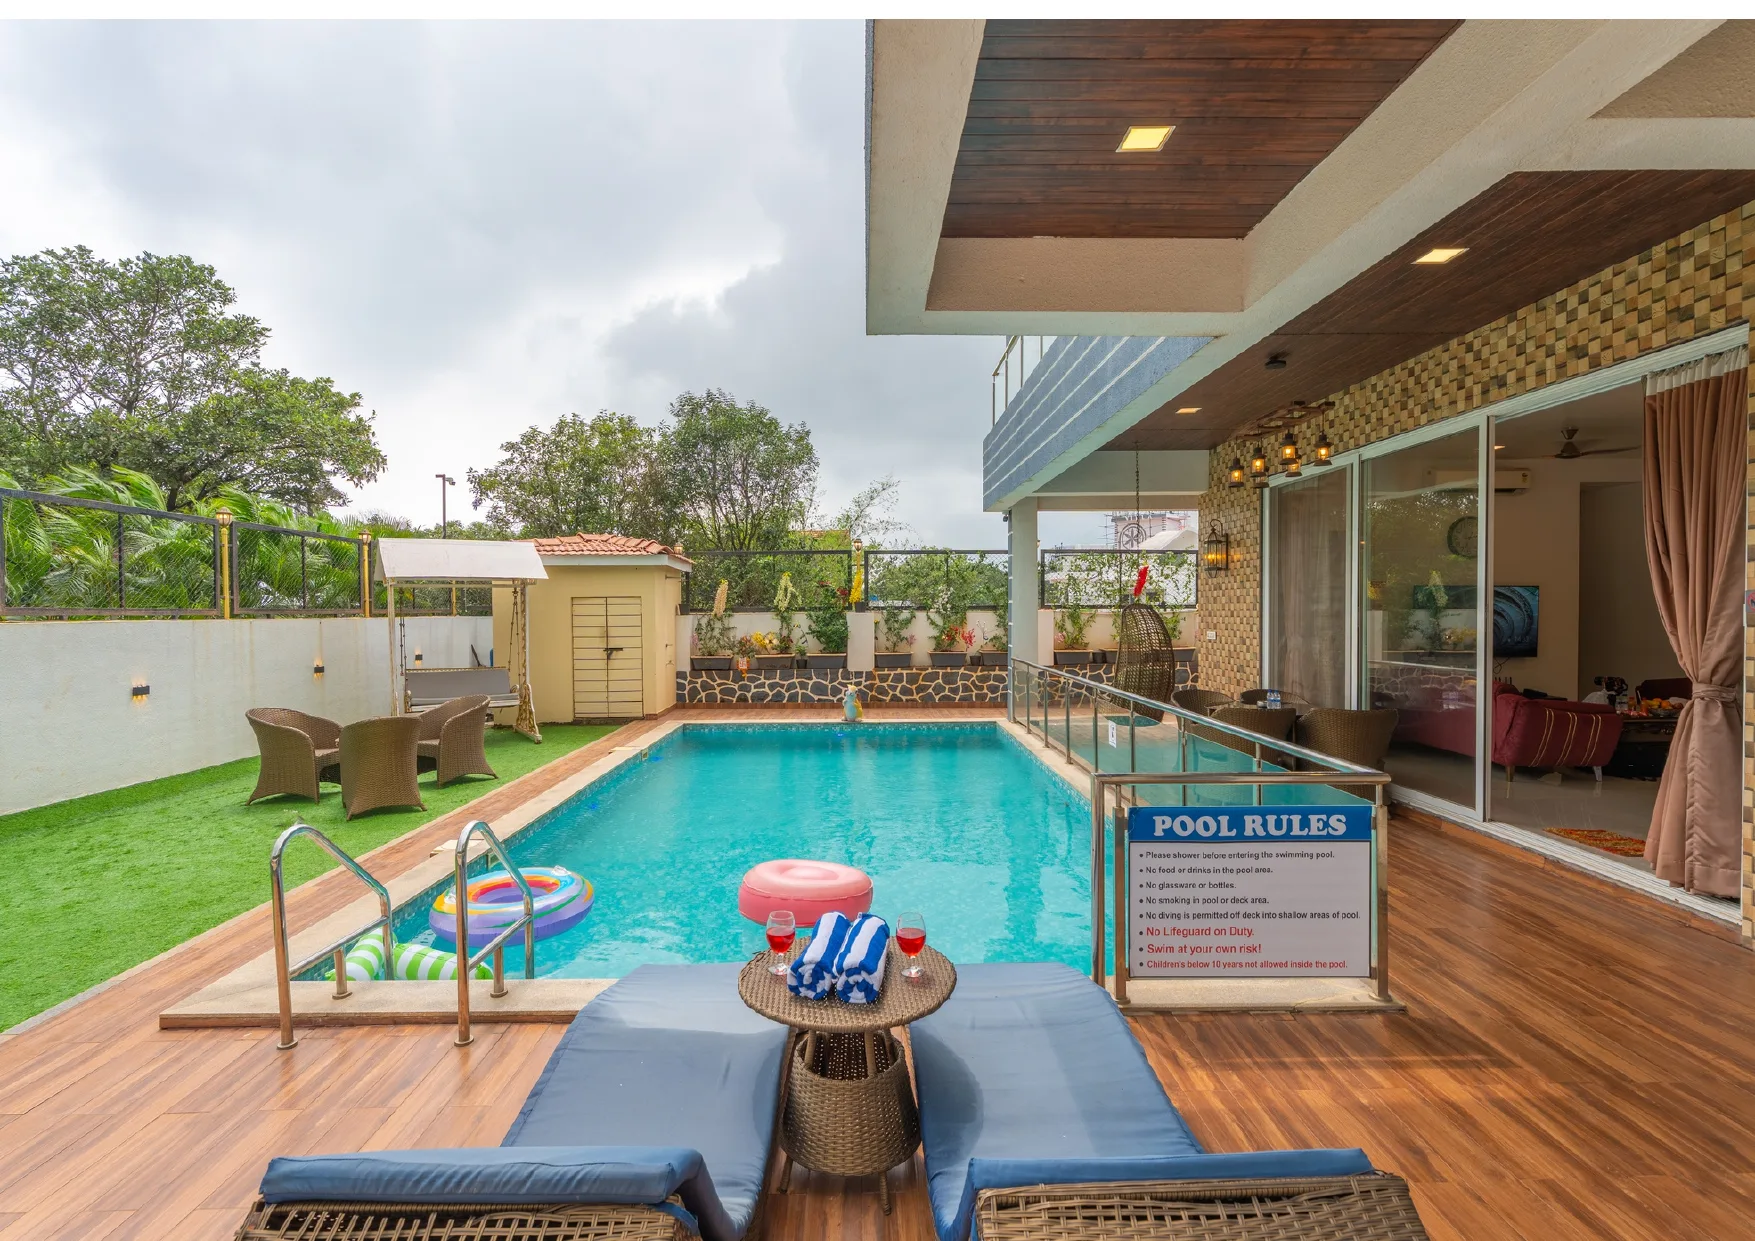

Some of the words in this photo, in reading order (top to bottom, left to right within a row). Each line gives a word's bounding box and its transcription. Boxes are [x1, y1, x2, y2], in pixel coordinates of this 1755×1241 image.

[1153, 815, 1237, 837] POOL
[1244, 814, 1347, 836] RULES
[1145, 851, 1172, 859] Please
[1172, 851, 1201, 859] shower
[1202, 851, 1227, 860] before
[1227, 850, 1260, 861] entering
[1260, 850, 1274, 859] the
[1275, 850, 1314, 860] swimming
[1315, 850, 1335, 860] pool.
[1145, 866, 1157, 874] No
[1158, 866, 1176, 874] food
[1187, 866, 1212, 874] drinks
[1212, 866, 1221, 874] in
[1221, 866, 1235, 874] the
[1235, 866, 1254, 876] pool
[1145, 881, 1157, 889] No
[1158, 881, 1197, 891] glassware
[1208, 881, 1237, 889] bottles.
[1145, 896, 1157, 905] No
[1158, 895, 1191, 906] smoking
[1192, 895, 1200, 904] in
[1201, 895, 1219, 905] pool
[1220, 897, 1229, 905] or
[1230, 895, 1249, 905] deck
[1145, 911, 1157, 920] No
[1158, 911, 1182, 921] diving
[1183, 911, 1190, 920] is
[1192, 911, 1229, 921] permitted
[1229, 910, 1241, 920] off
[1242, 911, 1261, 920] deck
[1261, 911, 1278, 920] into
[1278, 910, 1308, 920] shallow
[1309, 912, 1330, 920] areas
[1331, 910, 1341, 919] of
[1341, 910, 1361, 921] pool.
[1146, 926, 1161, 937] No
[1163, 926, 1212, 939] Lifeguard
[1213, 928, 1227, 936] on
[1229, 926, 1255, 938] Duty.
[1146, 943, 1175, 954] Swim
[1177, 944, 1188, 954] at
[1189, 945, 1214, 956] your
[1215, 945, 1237, 954] own
[1239, 943, 1262, 954] risk!
[1146, 960, 1186, 969] Children's
[1187, 960, 1211, 969] below
[1211, 960, 1221, 969] 10
[1222, 961, 1244, 970] years
[1244, 960, 1258, 969] not
[1259, 960, 1289, 969] allowed
[1290, 960, 1314, 969] inside
[1314, 960, 1328, 969] the
[1328, 960, 1348, 970] pool.
